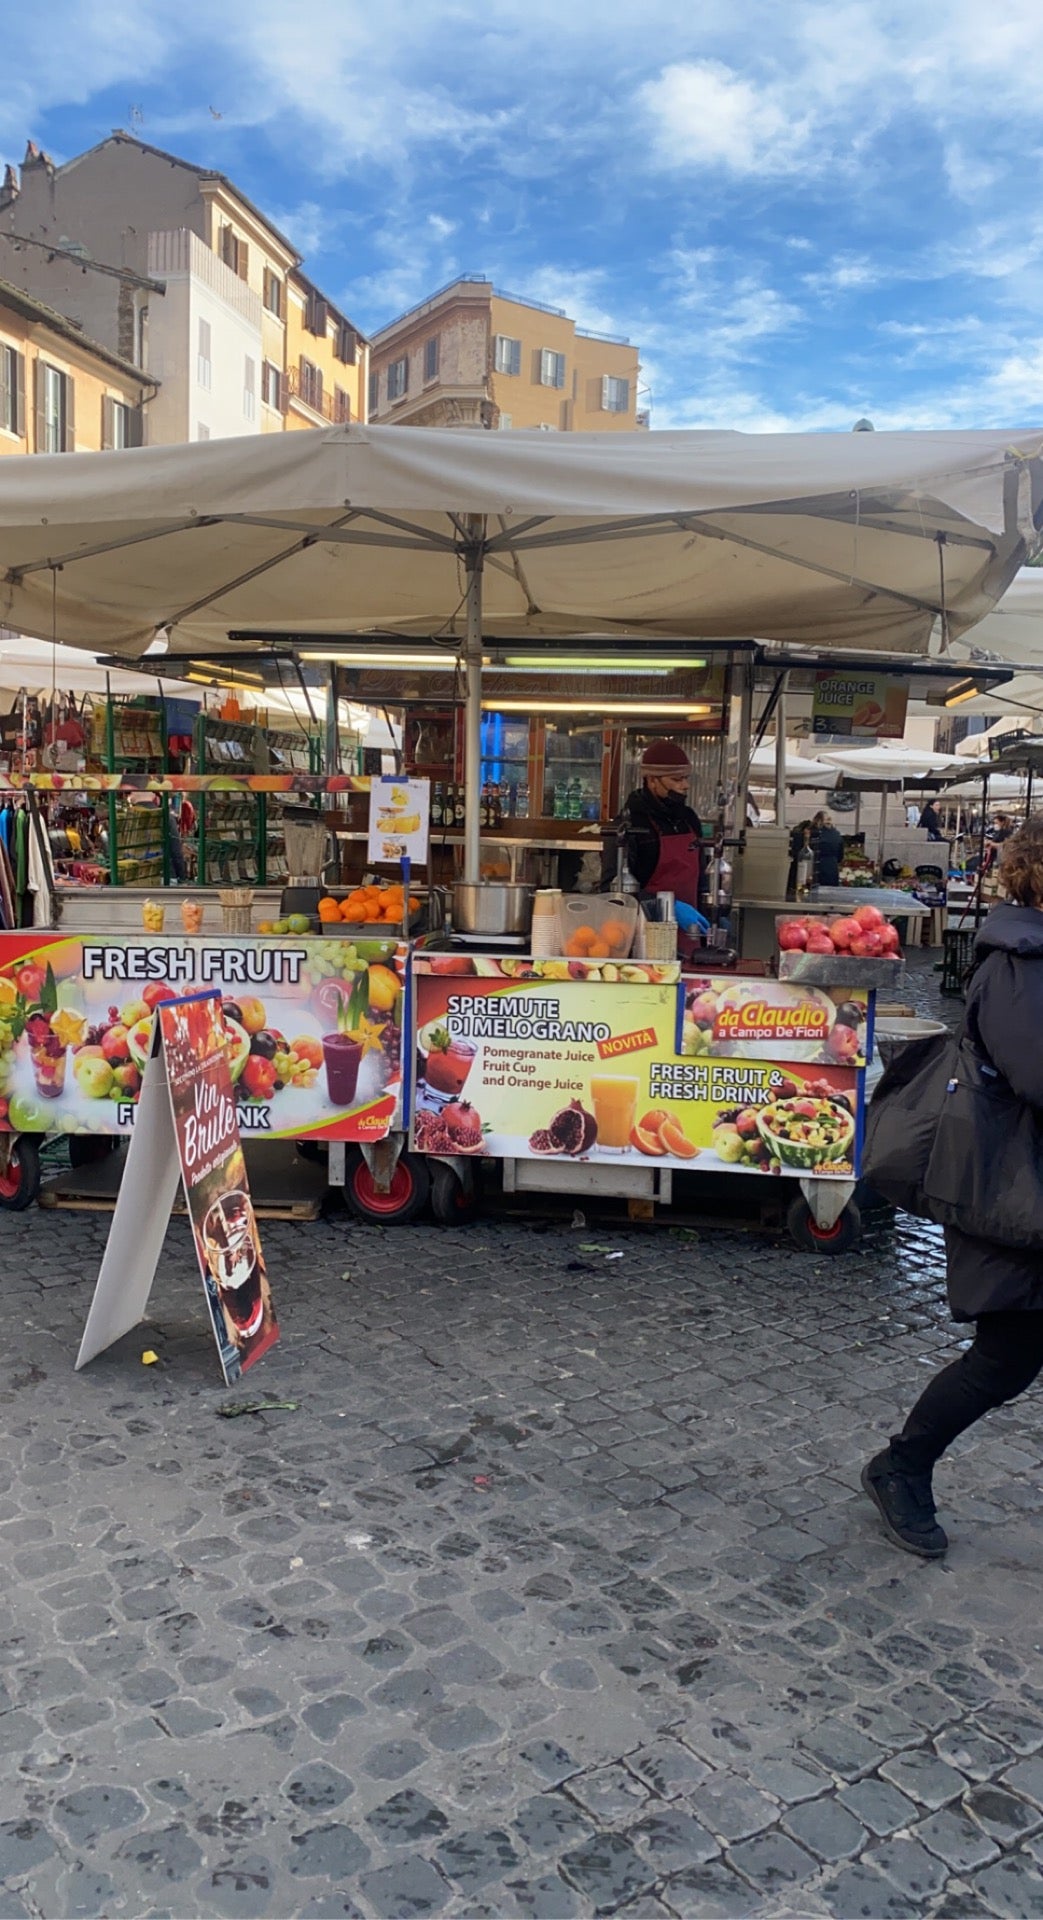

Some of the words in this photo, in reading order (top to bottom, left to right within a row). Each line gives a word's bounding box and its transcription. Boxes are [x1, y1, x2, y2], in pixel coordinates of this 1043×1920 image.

[818, 692, 854, 705] JUICE
[820, 680, 874, 694] ORANGE
[83, 947, 195, 981] FRESH
[202, 949, 307, 983] FRUIT
[447, 994, 560, 1018] SPREMUTE
[718, 1009, 739, 1026] da
[741, 1002, 826, 1026] Claudio
[446, 1015, 470, 1037] DI
[473, 1018, 611, 1043] MELOGRANO
[719, 1028, 726, 1037] a
[729, 1027, 772, 1039] Campo
[483, 1046, 563, 1061] Pomegranate
[564, 1050, 595, 1062] Juice
[602, 1030, 653, 1056] NOVITÀ
[483, 1060, 511, 1072] Fruit
[513, 1062, 536, 1075] Cup
[650, 1063, 708, 1082] FRESH
[712, 1066, 767, 1087] FRUIT
[769, 1068, 785, 1087] &
[482, 1075, 506, 1087] and
[507, 1076, 552, 1092] Orange
[554, 1078, 584, 1090] Juice
[649, 1081, 708, 1101] FRESH
[711, 1084, 771, 1104] DRINK
[194, 1078, 219, 1119] Vin
[184, 1095, 236, 1167] Brulè
